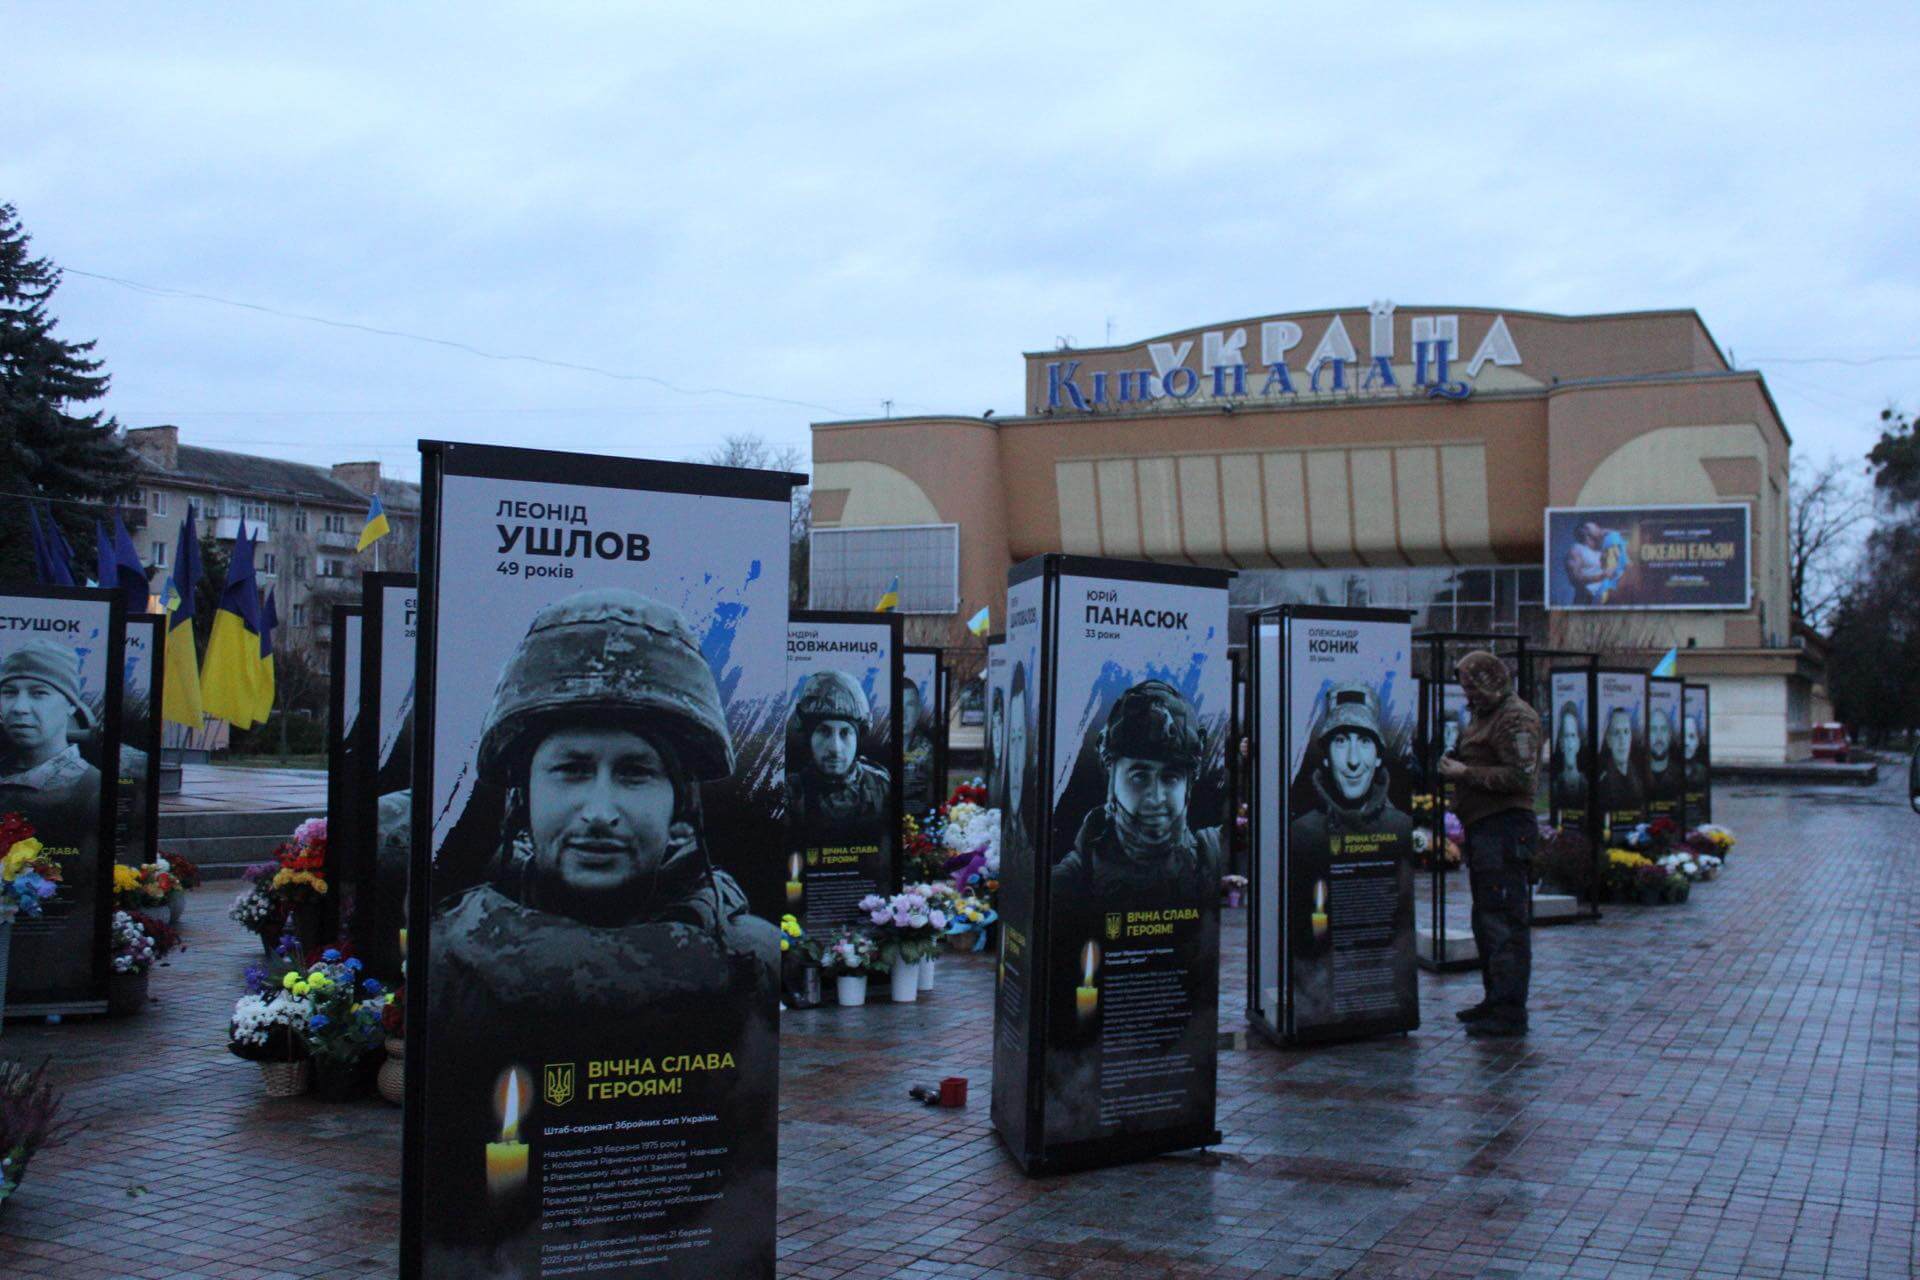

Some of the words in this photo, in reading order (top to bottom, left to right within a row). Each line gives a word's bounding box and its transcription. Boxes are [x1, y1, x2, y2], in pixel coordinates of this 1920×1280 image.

[1148, 300, 1522, 397] УКРАЇНА
[496, 500, 588, 525] ЛЕОНІД
[496, 524, 651, 562] УШЛОВ
[496, 561, 519, 575] 49
[525, 563, 574, 579] років
[1087, 590, 1118, 603] ЮРІЙ
[1086, 605, 1189, 630] ПАНАСЮК
[1085, 629, 1095, 638] 33
[1098, 631, 1120, 640] роки
[1308, 629, 1360, 639] ОЛЕКСАНДР
[787, 640, 878, 654] ДОВЖАНИЦЯ
[1309, 640, 1359, 654] КОНИК
[850, 845, 879, 853] СЛАВА
[1127, 910, 1160, 923] ВІЧНА
[1163, 909, 1199, 920] СЛАВА
[1127, 923, 1174, 936] ГЕРОЯМ!
[588, 1058, 656, 1078] ВІЧНА
[661, 1052, 735, 1072] СЛАВА
[588, 1078, 682, 1100] ГЕРОЯМ!
[544, 1123, 612, 1135] Штаб-сержант
[615, 1119, 660, 1129] Збройних
[660, 1140, 679, 1149] року
